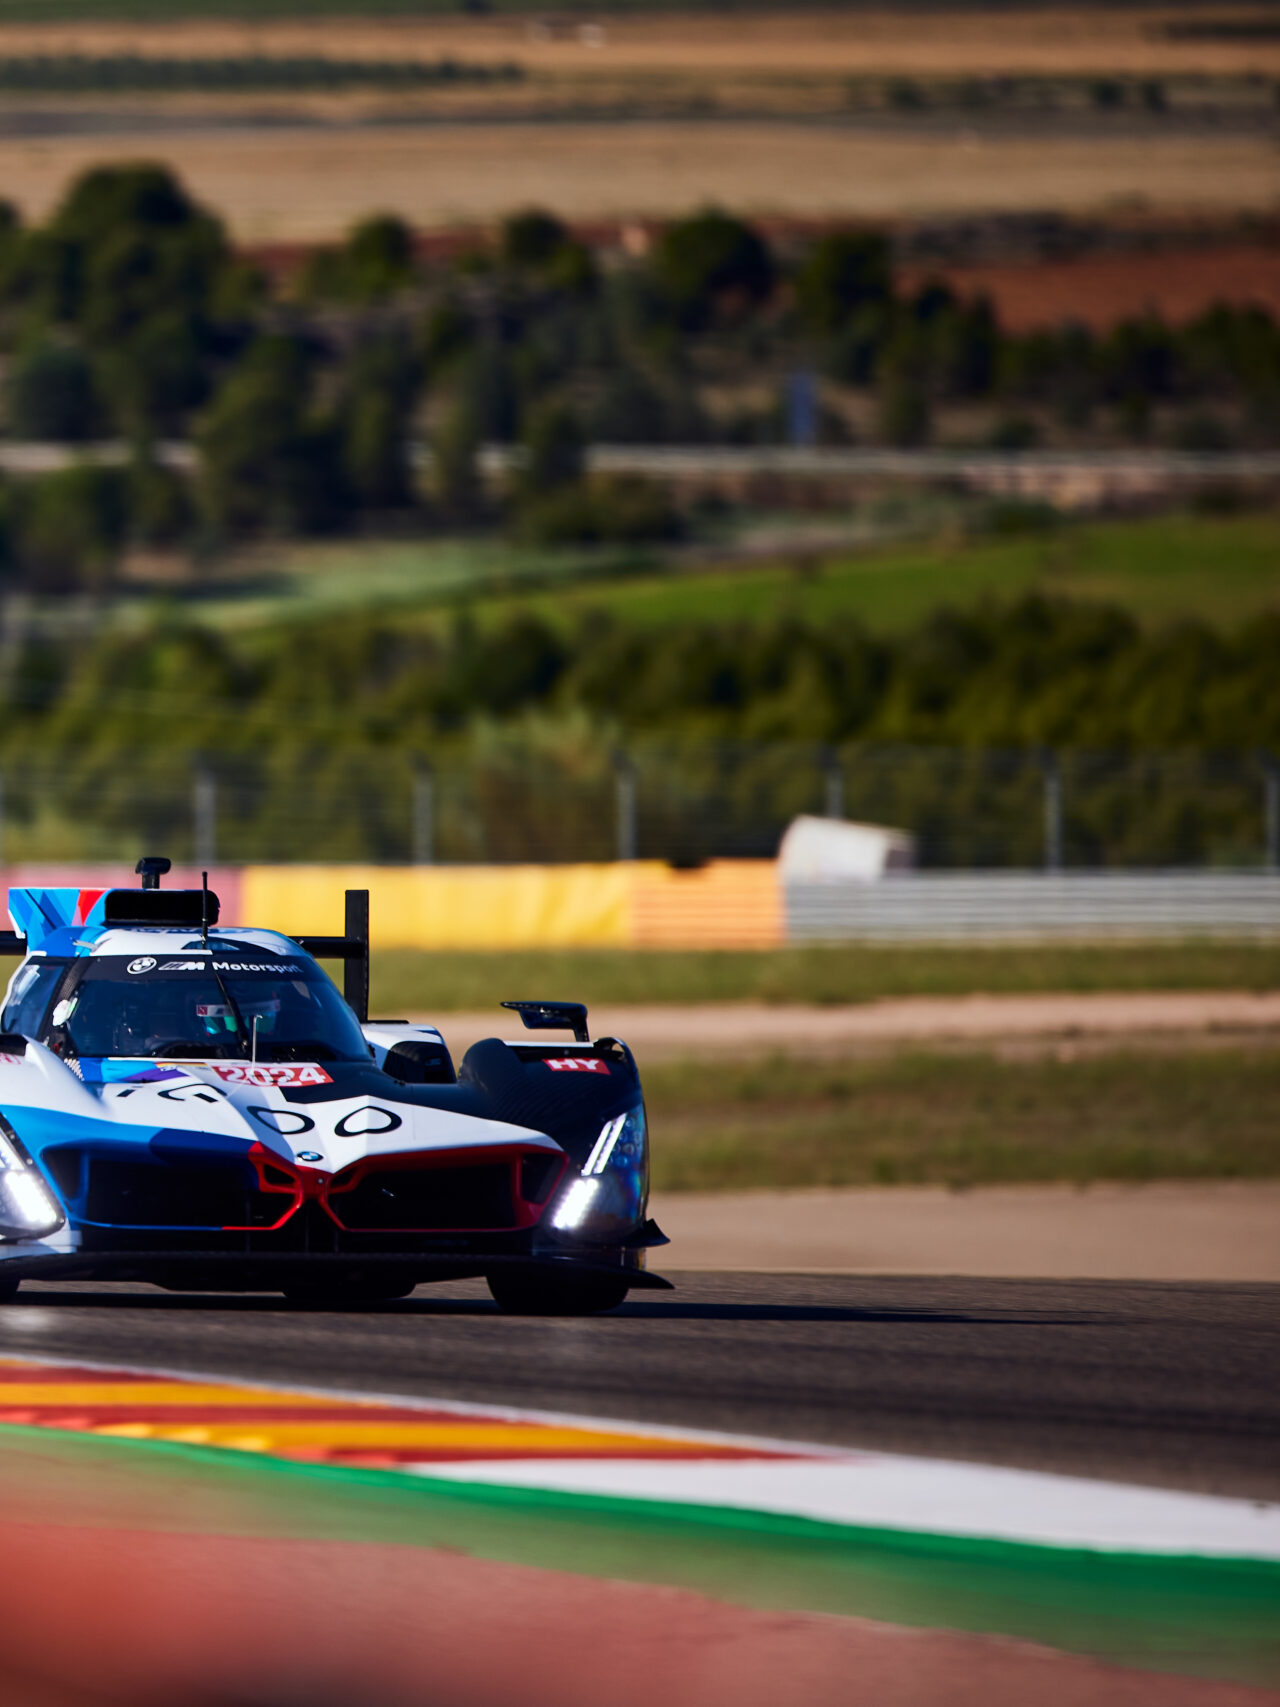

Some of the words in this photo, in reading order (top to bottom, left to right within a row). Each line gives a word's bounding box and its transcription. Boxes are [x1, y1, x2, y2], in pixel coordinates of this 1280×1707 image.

[212, 961, 304, 975] Motorsport
[548, 1058, 600, 1071] HY
[220, 1066, 327, 1087] 2024
